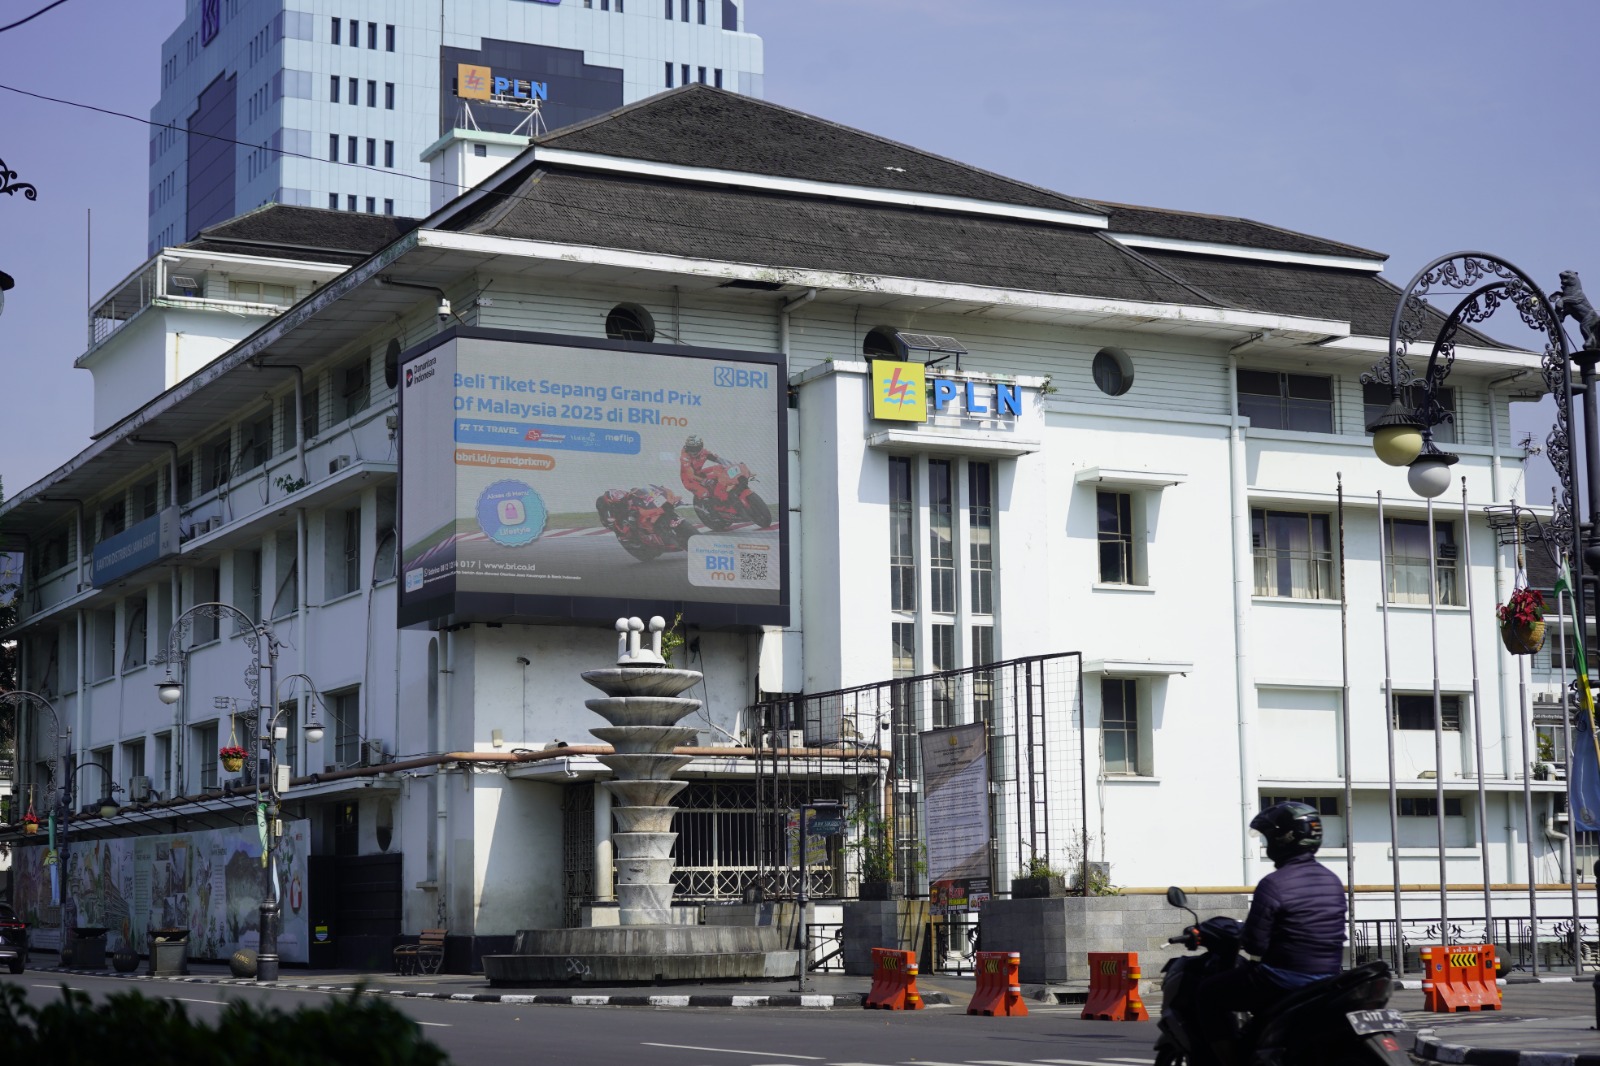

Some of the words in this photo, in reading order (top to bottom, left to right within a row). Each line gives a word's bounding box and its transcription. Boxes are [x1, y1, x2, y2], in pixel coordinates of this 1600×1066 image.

[494, 76, 547, 100] PLN
[414, 357, 437, 374] Danantara
[414, 367, 435, 384] Indonesia
[736, 369, 768, 389] BRI
[453, 373, 485, 389] Beli
[488, 376, 536, 393] Tiket
[539, 380, 607, 402] Sepang
[610, 386, 664, 403] Grand
[668, 391, 702, 406] Prix
[933, 379, 1022, 416] PLN
[478, 397, 557, 418] Malaysia
[561, 404, 602, 421] 2025
[606, 407, 623, 423] di
[473, 424, 484, 432] TX
[487, 425, 519, 435] TRAVEL
[501, 527, 531, 536] Lifestyle
[484, 562, 535, 571] www.bri.co.id
[705, 556, 734, 570] BRI
[711, 571, 735, 581] mo
